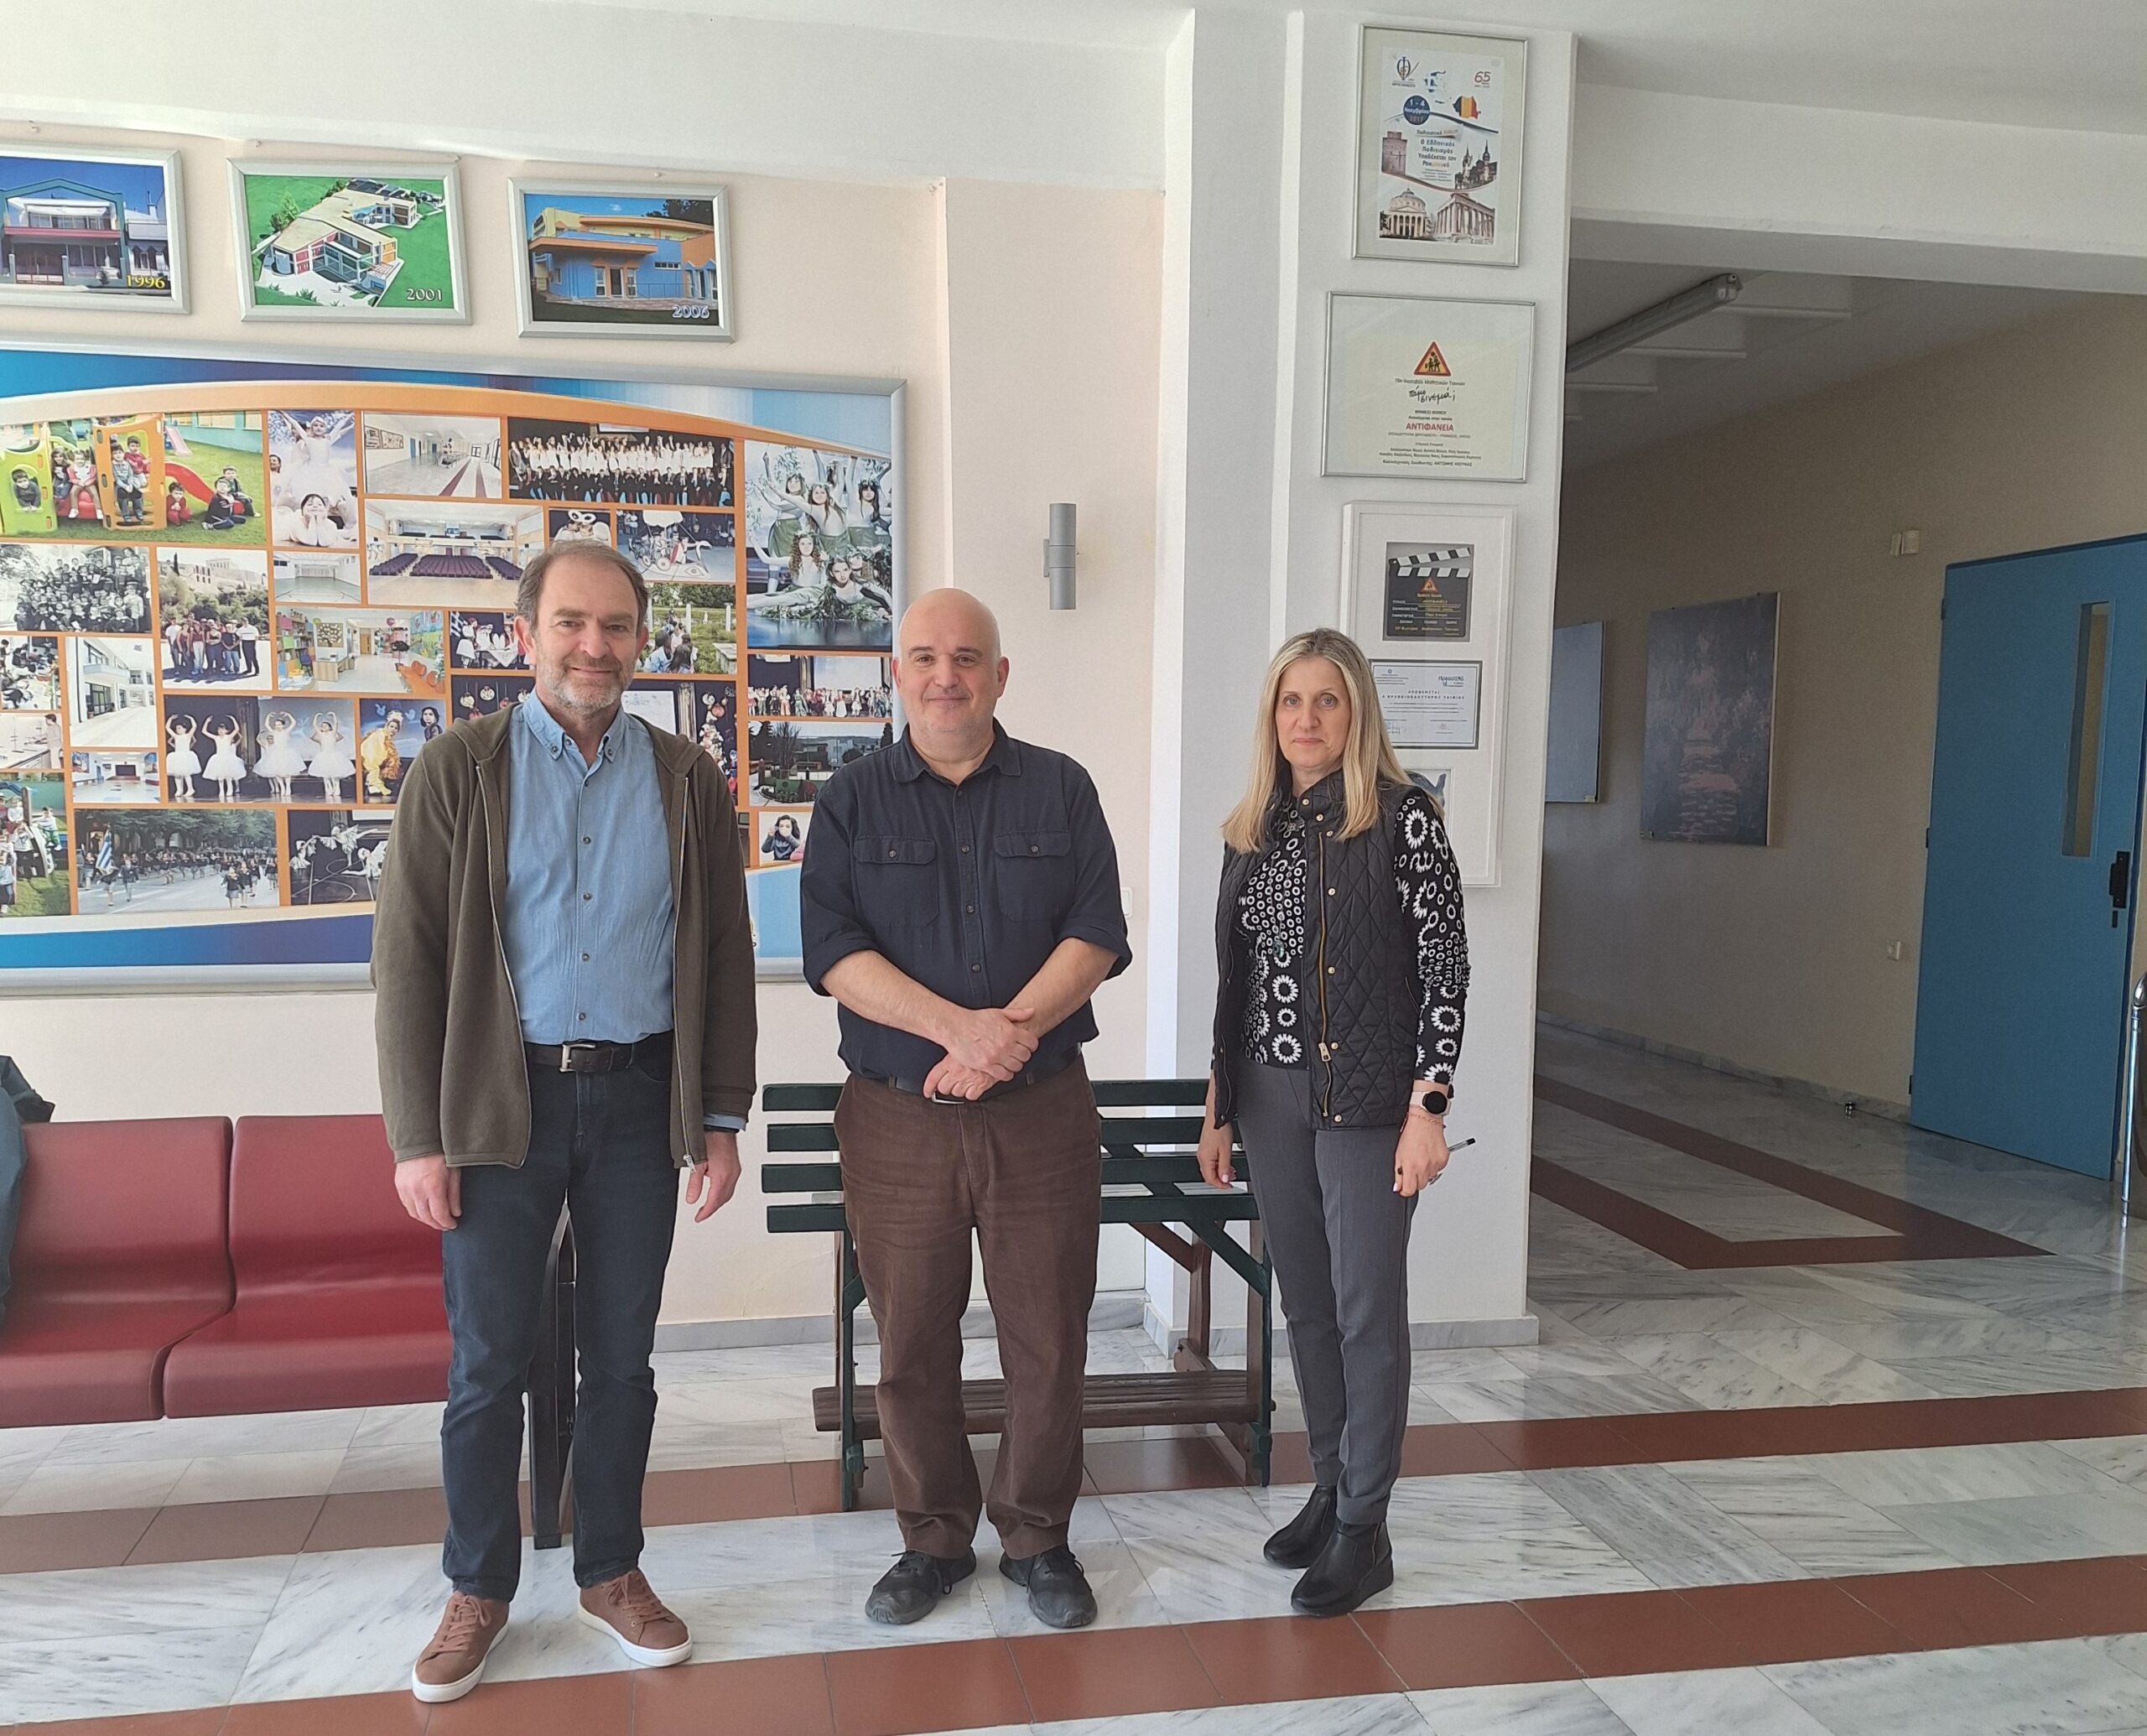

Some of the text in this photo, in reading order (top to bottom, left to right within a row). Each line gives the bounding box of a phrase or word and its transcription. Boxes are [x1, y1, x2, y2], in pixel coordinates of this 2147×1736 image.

[1474, 71, 1491, 83] 65
[127, 274, 165, 288] 1996
[407, 288, 442, 301] 2001
[672, 304, 710, 319] 2006
[1406, 423, 1454, 431] ΑΝΤΙΦΑΝΕΙΑ
